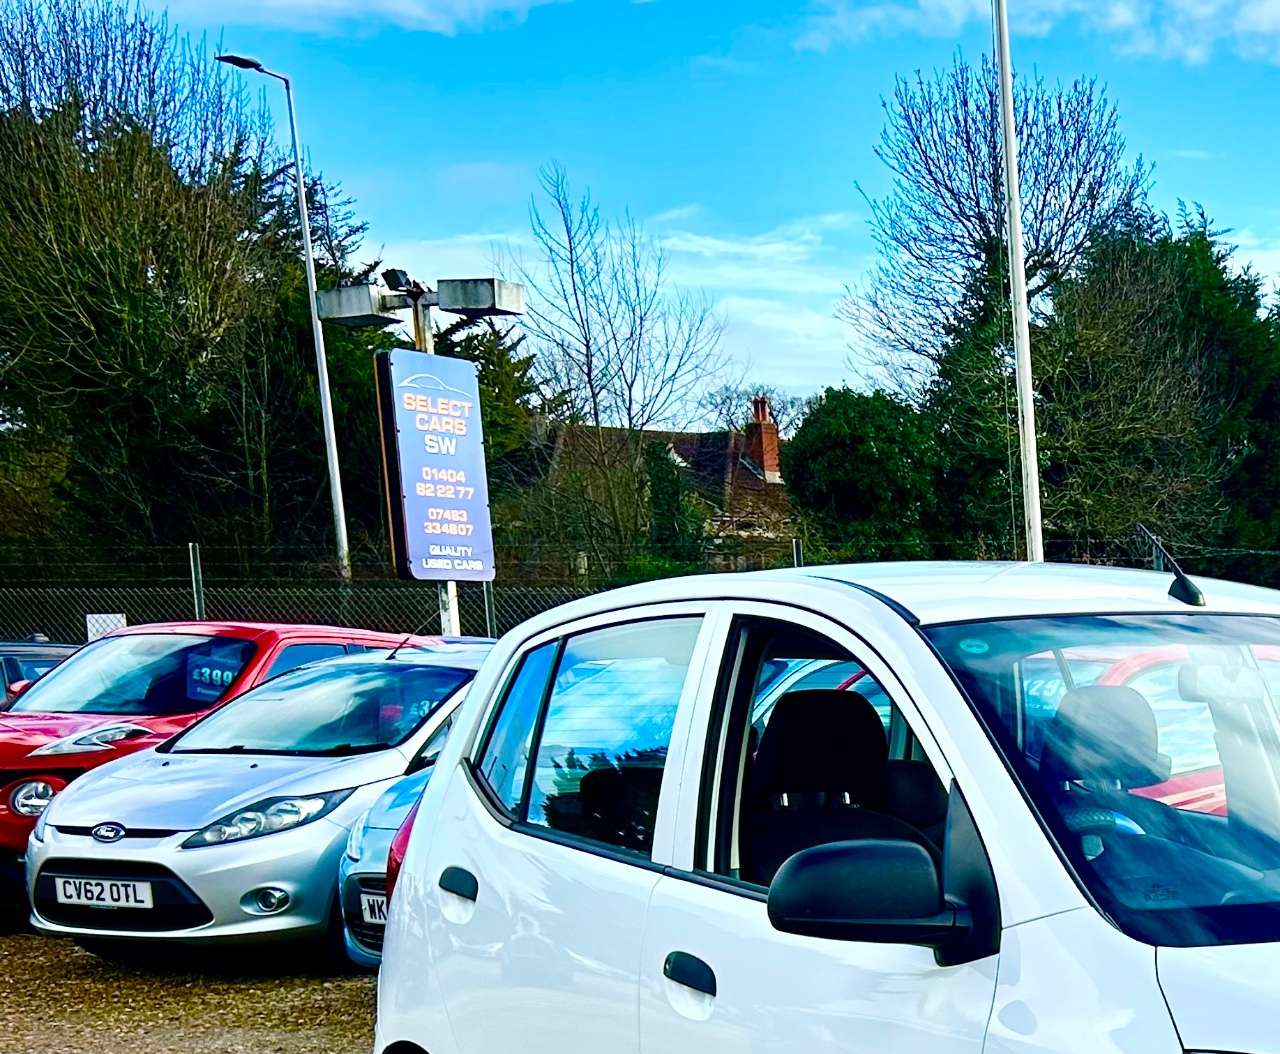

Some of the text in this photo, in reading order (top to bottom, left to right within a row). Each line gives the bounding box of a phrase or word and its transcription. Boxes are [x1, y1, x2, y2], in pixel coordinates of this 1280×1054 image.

[403, 392, 473, 418] SELECT
[416, 413, 467, 436] CARS
[424, 433, 457, 456] SW
[422, 466, 466, 483] 01404
[429, 544, 473, 557] QUALITY
[422, 558, 484, 571] USED CARS
[192, 667, 238, 686] £399
[62, 880, 145, 904] CV62 OTL
[367, 899, 388, 921] WK
